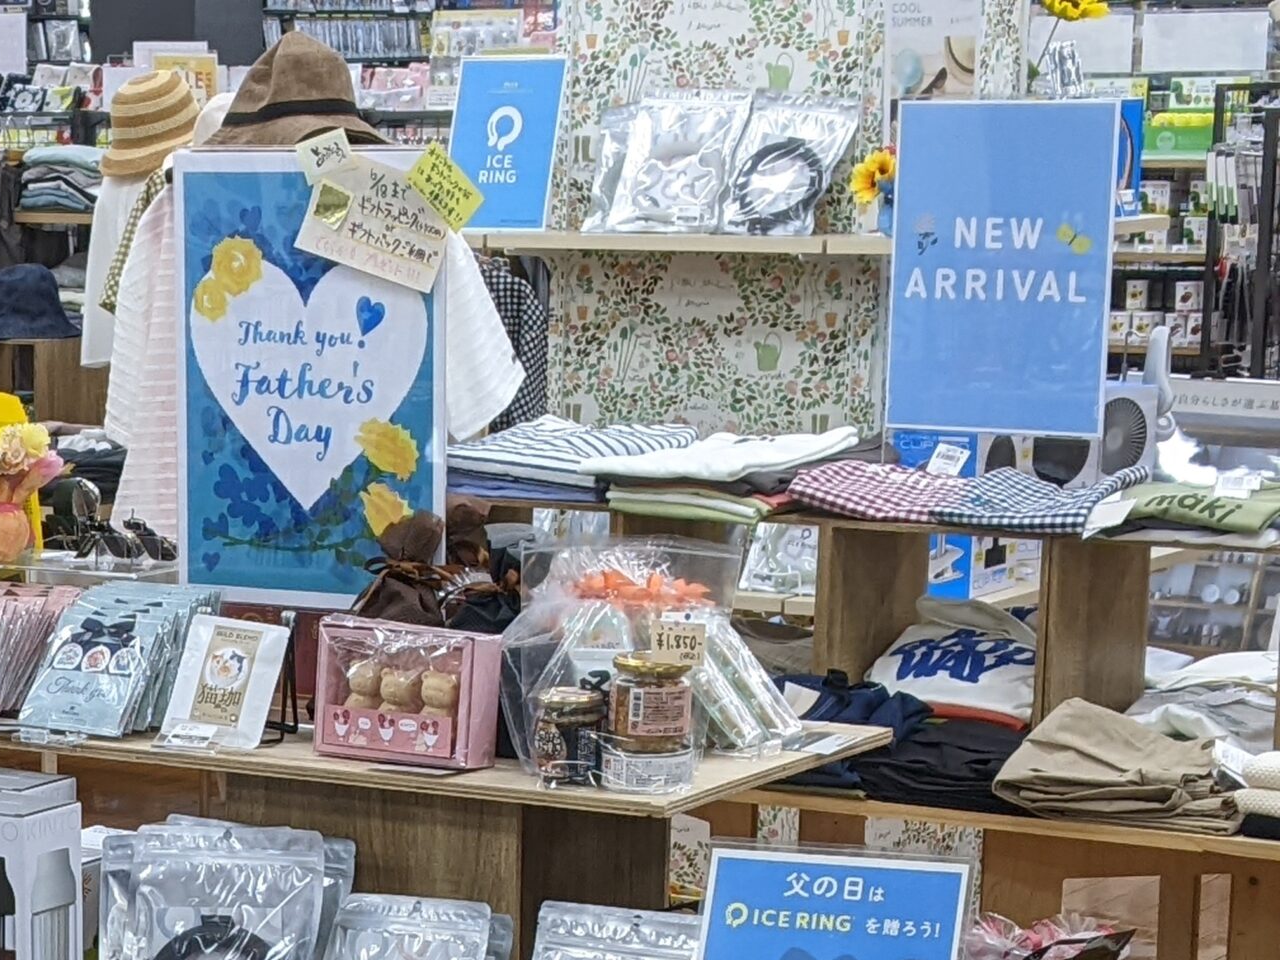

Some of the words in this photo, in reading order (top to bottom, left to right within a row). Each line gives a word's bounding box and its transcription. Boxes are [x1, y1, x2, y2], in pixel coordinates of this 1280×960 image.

[478, 169, 517, 184] RING
[485, 154, 513, 169] ICE
[954, 216, 1044, 250] NEW
[904, 266, 1087, 303] ARRIVAL
[237, 320, 308, 346] Thank
[231, 360, 375, 406] Father's
[266, 405, 333, 462] Day
[783, 872, 885, 902] 父の日は
[752, 908, 792, 927] ICE
[795, 911, 852, 933] RING
[865, 918, 941, 938] を贈ろう!
